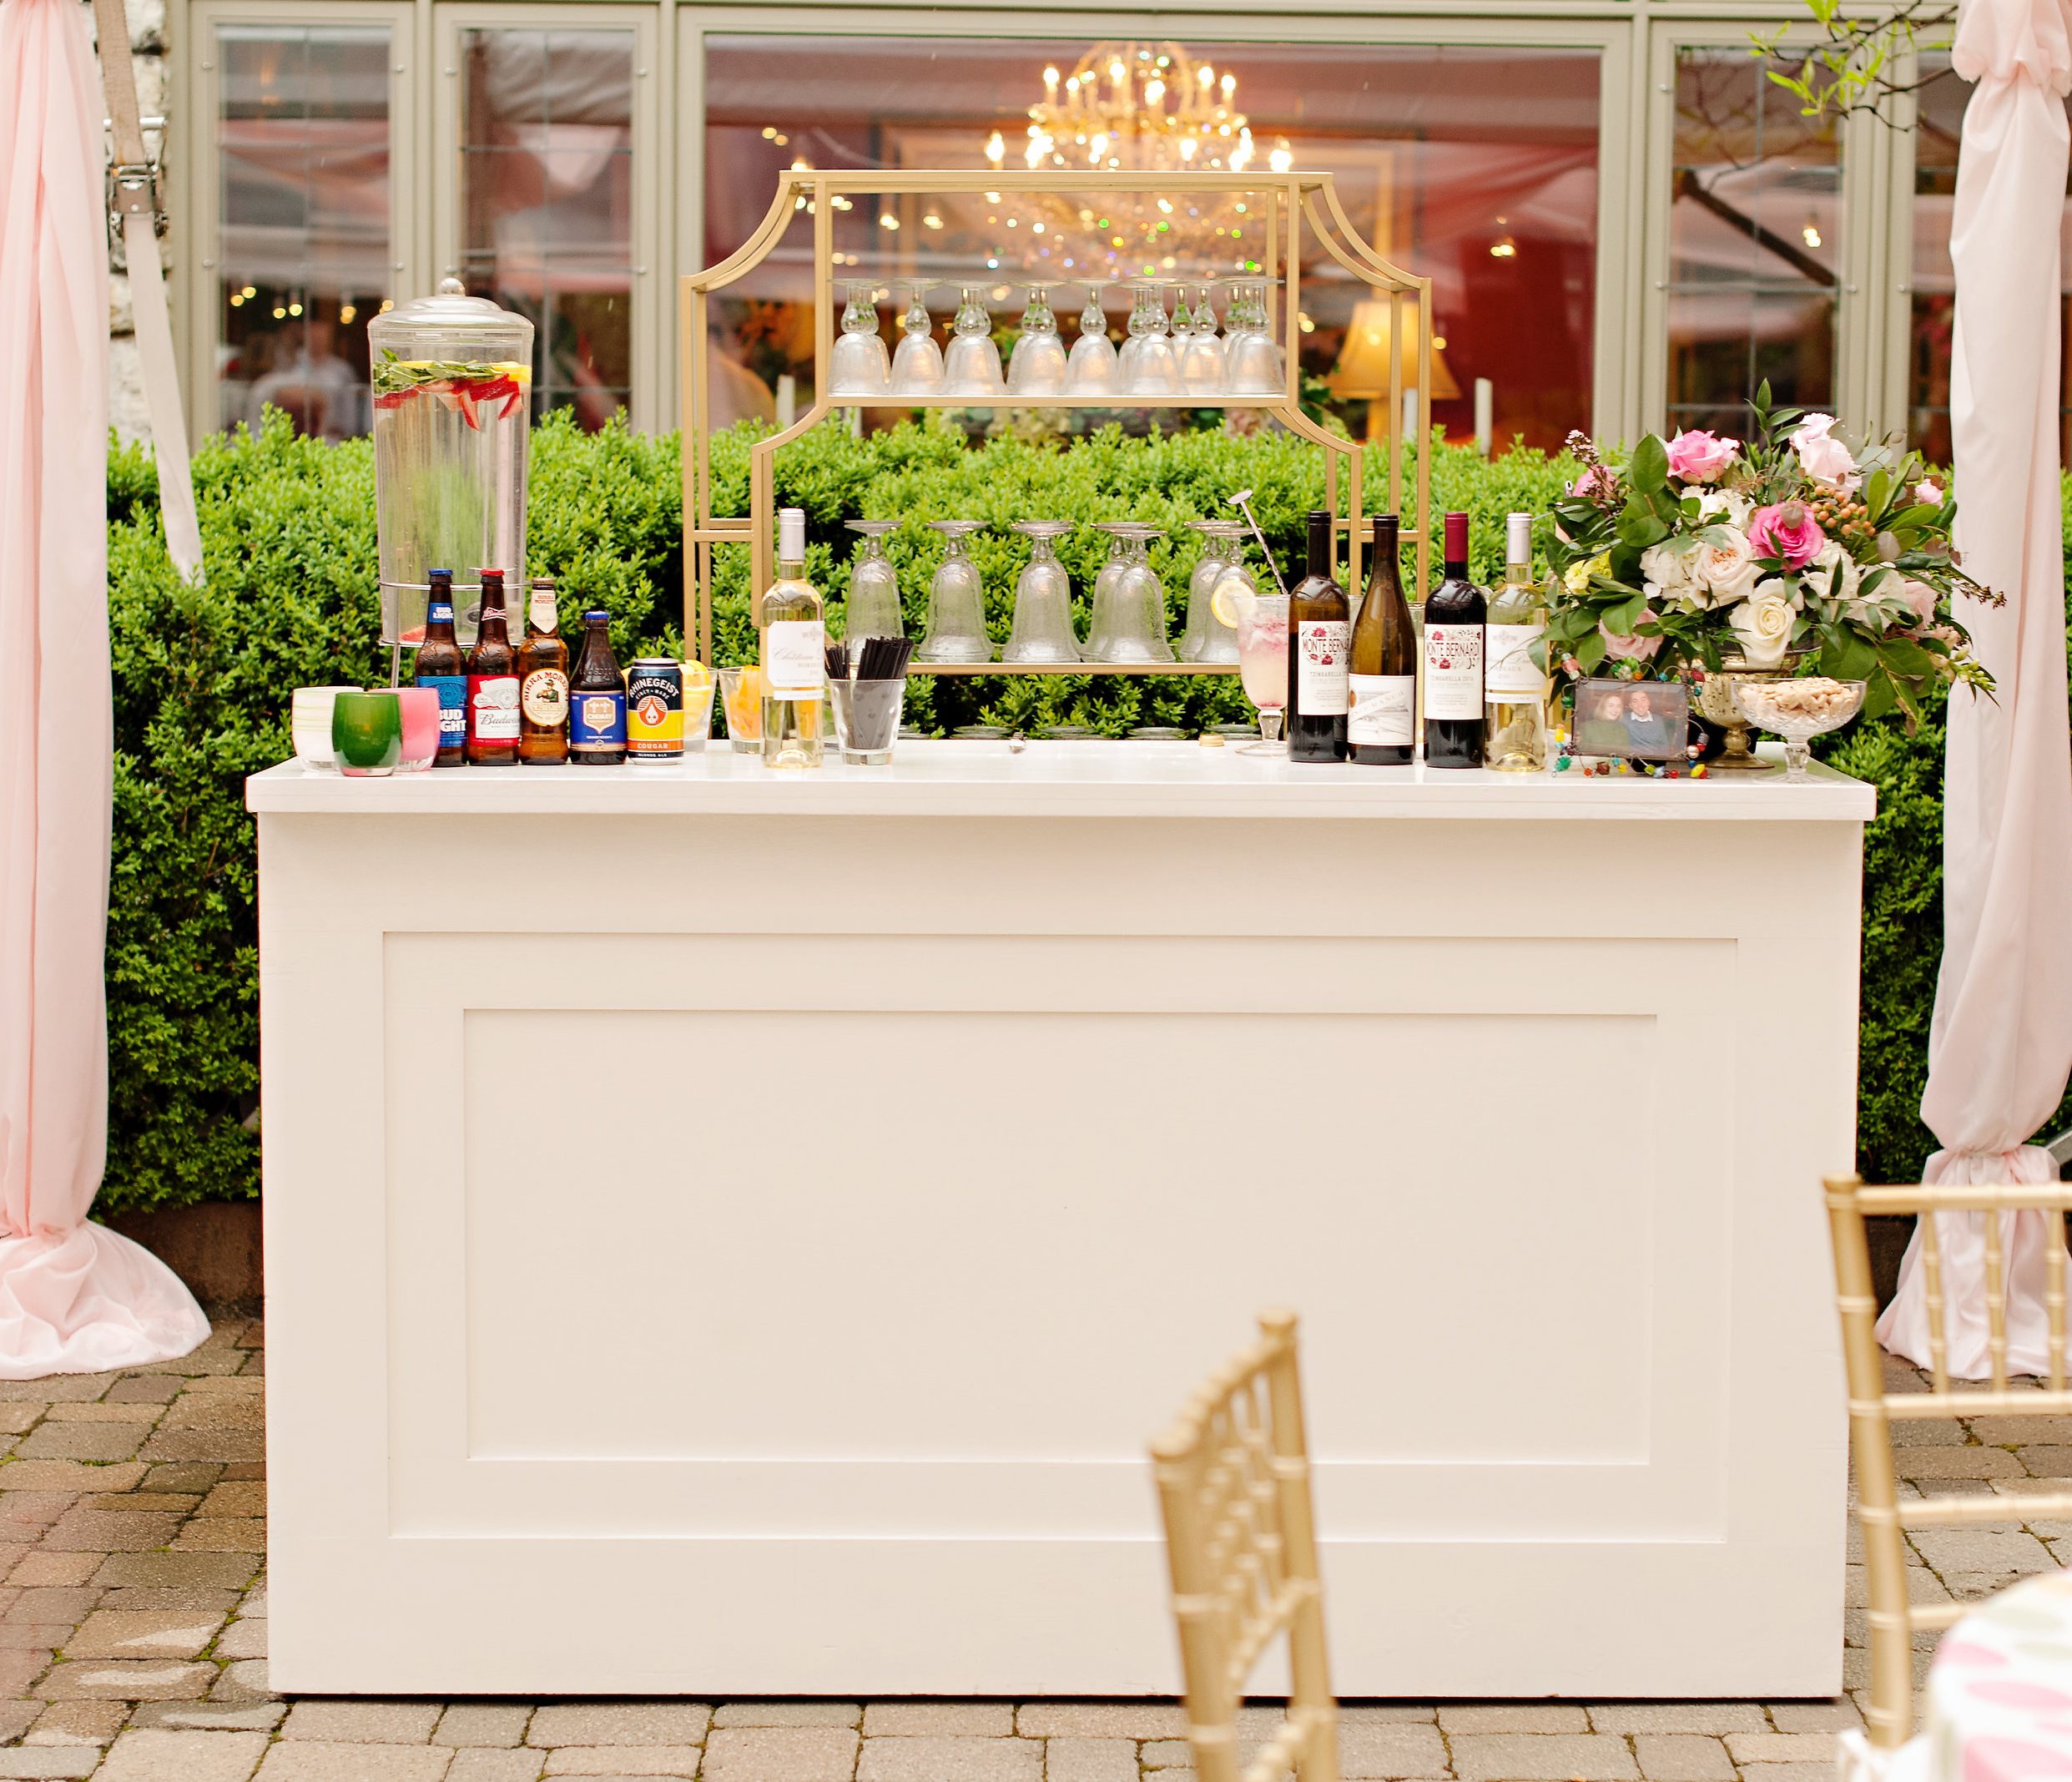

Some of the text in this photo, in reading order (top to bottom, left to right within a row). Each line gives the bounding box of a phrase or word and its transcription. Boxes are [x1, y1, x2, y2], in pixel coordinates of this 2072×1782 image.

[1302, 638, 1350, 653] MONTE BERNA
[1446, 642, 1480, 657] BERNARDI
[524, 674, 543, 701] BIRRA
[628, 677, 680, 699] RHINEGEIST
[440, 719, 467, 733] GHT
